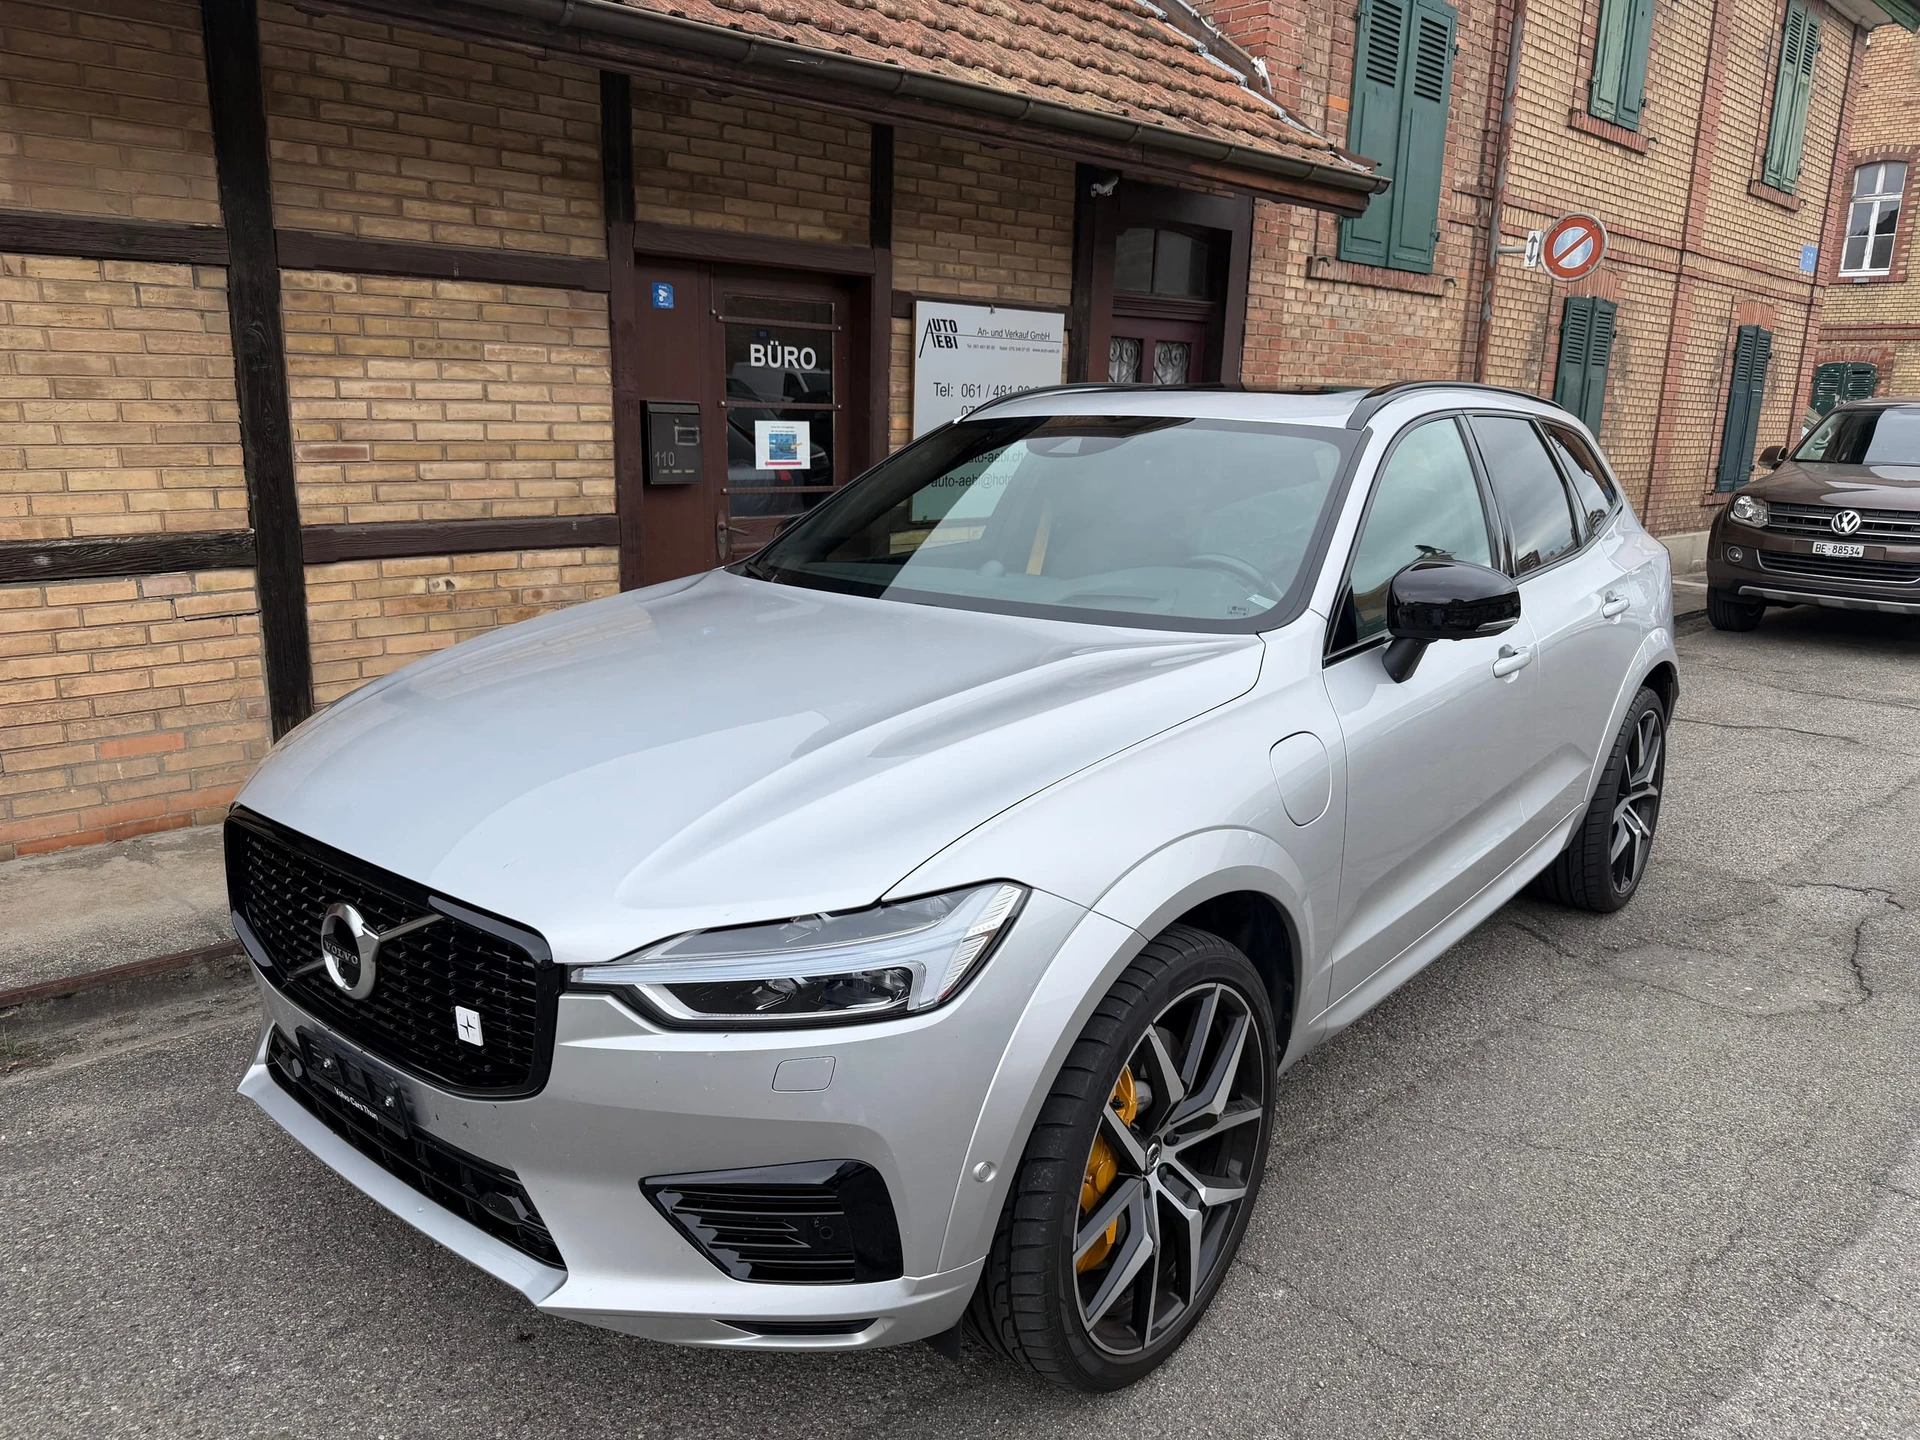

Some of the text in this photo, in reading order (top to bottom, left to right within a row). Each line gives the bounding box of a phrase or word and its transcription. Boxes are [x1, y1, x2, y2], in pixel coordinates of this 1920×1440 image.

[977, 327, 1050, 341] An- und Verkauf GmbH
[750, 341, 816, 370] BÜRO
[933, 382, 953, 397] Tel:
[961, 384, 981, 398] 061
[993, 385, 1013, 398] 481
[961, 405, 976, 416] 07
[655, 451, 675, 467] 110
[324, 940, 358, 964] VOLVO
[333, 1086, 350, 1102] Volvo
[350, 1097, 363, 1111] Cars
